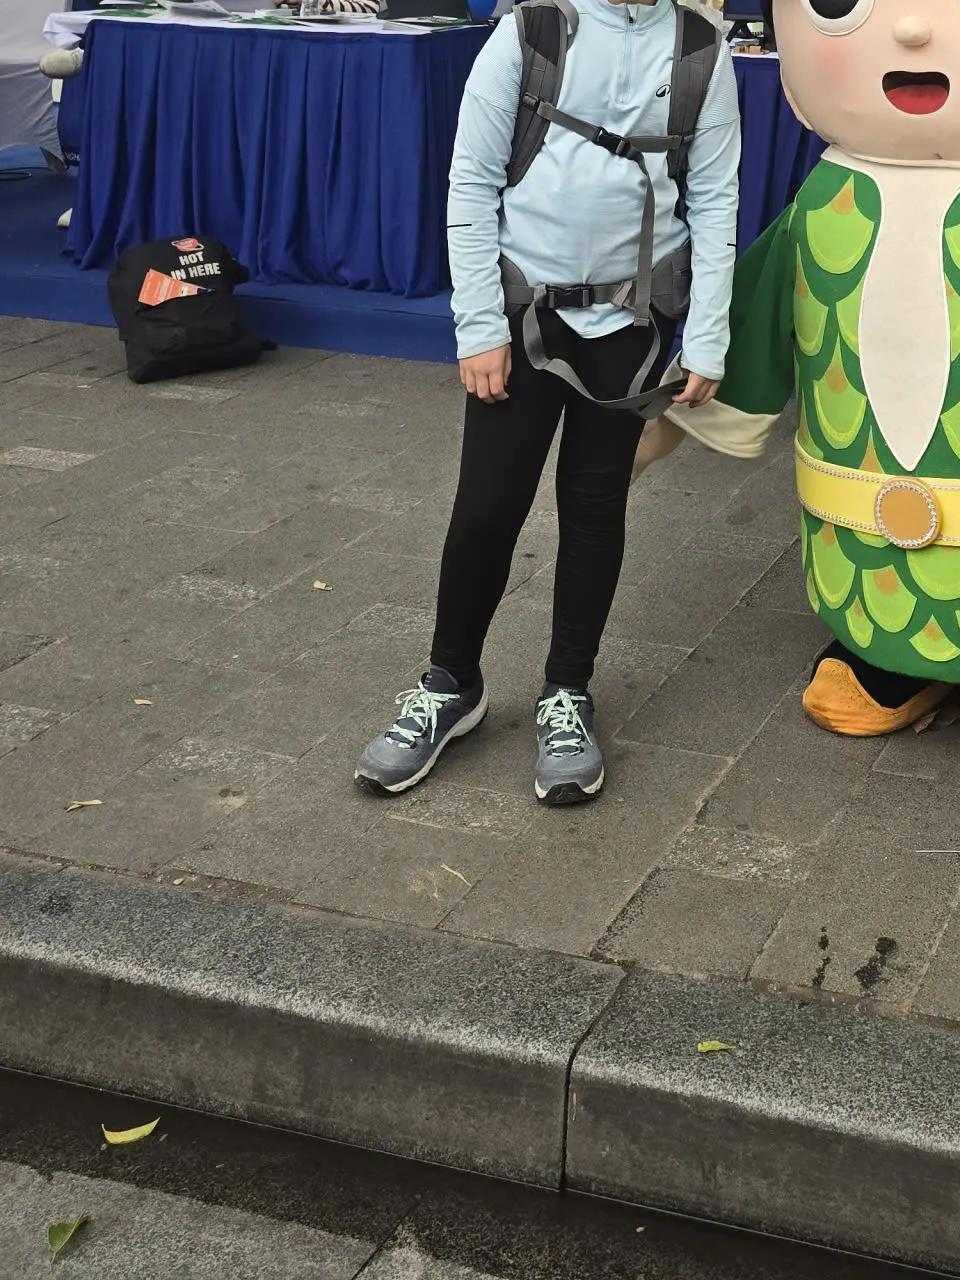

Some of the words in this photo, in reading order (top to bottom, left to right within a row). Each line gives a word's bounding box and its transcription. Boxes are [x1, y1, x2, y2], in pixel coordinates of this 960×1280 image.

[179, 252, 204, 266] HOT
[171, 269, 187, 281] IN
[188, 263, 221, 278] HERE
